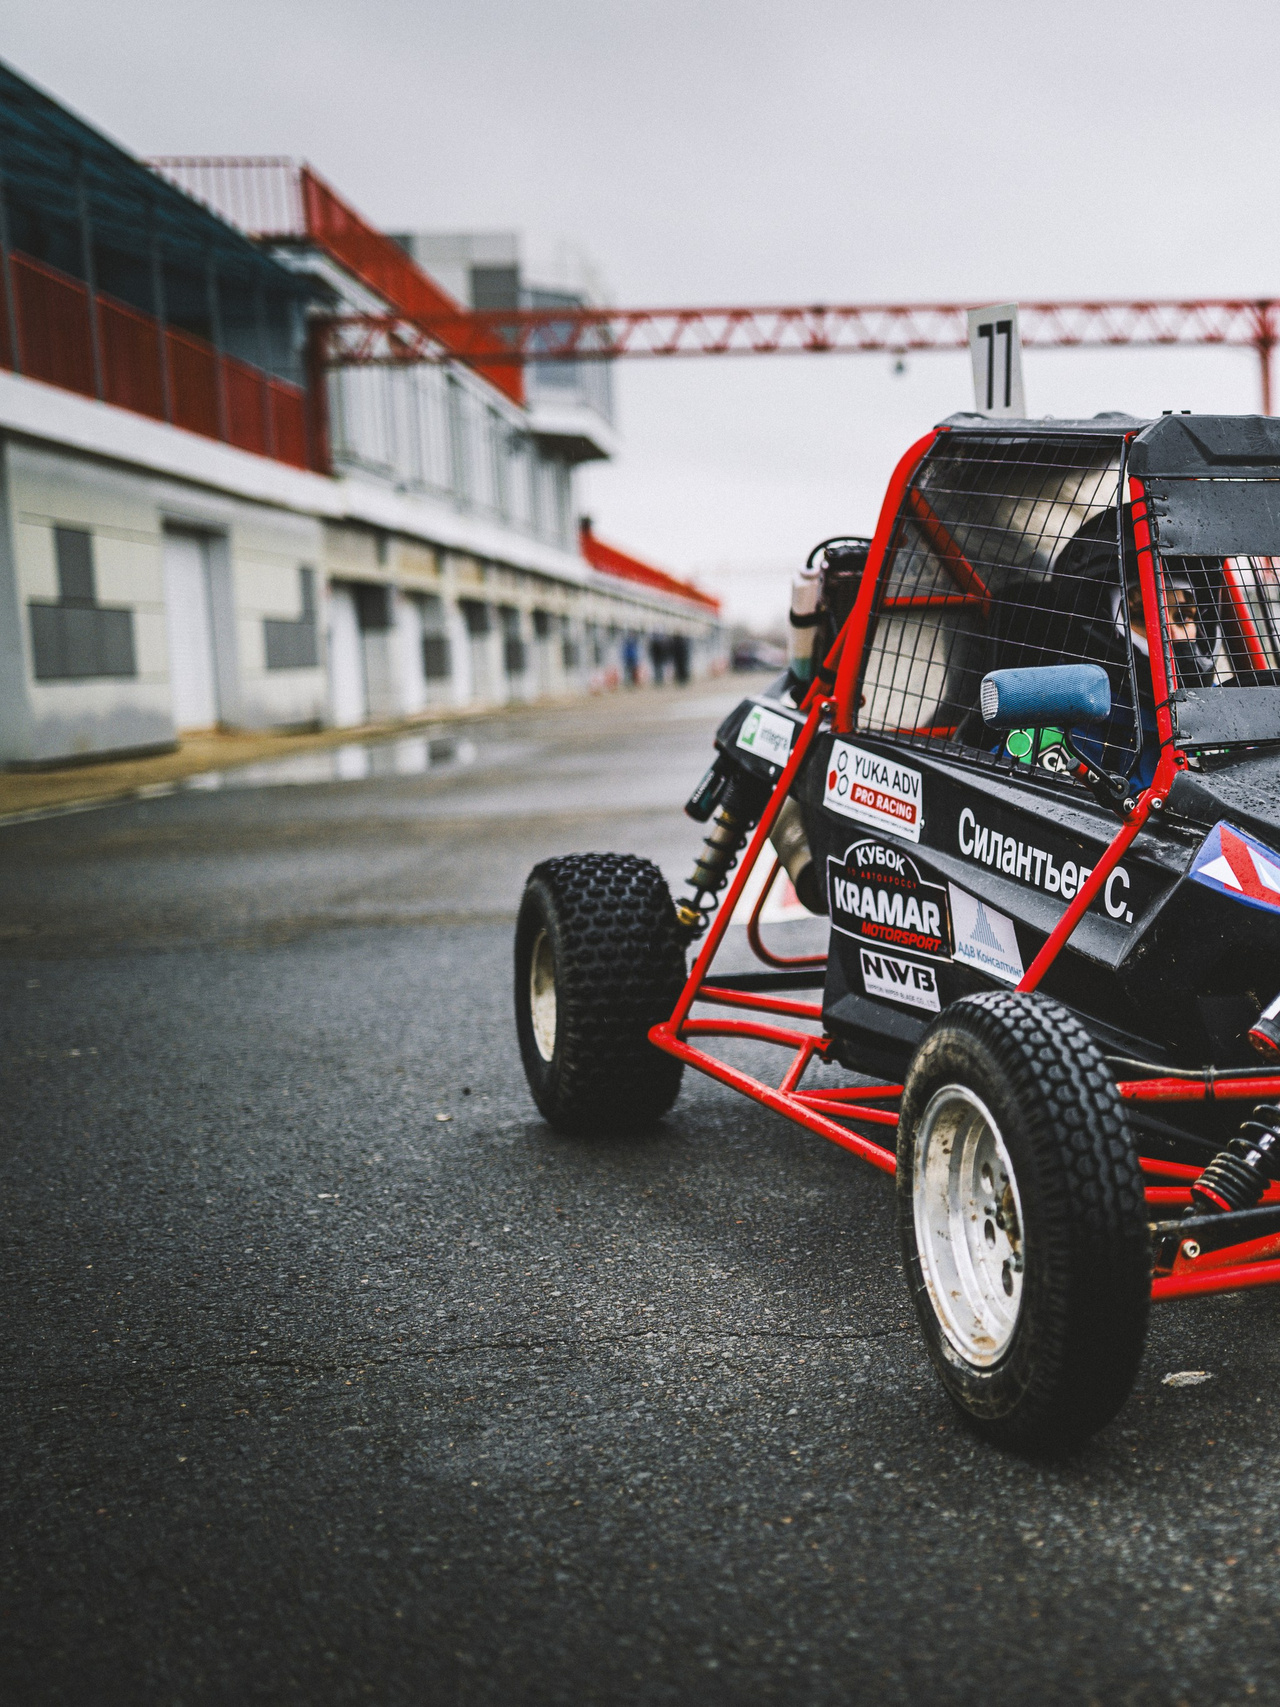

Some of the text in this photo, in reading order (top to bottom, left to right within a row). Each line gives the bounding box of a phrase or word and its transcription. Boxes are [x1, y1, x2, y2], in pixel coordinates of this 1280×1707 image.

[855, 755, 919, 798] YUKA ADV
[854, 787, 875, 806] PRO
[876, 795, 912, 820] RACING
[856, 846, 906, 876] КУБОК
[834, 876, 942, 937] KRAMAR
[1104, 866, 1134, 924] С.
[861, 921, 942, 952] MOTORSPORT
[958, 941, 976, 959] АДВ
[862, 952, 935, 993] NWB
